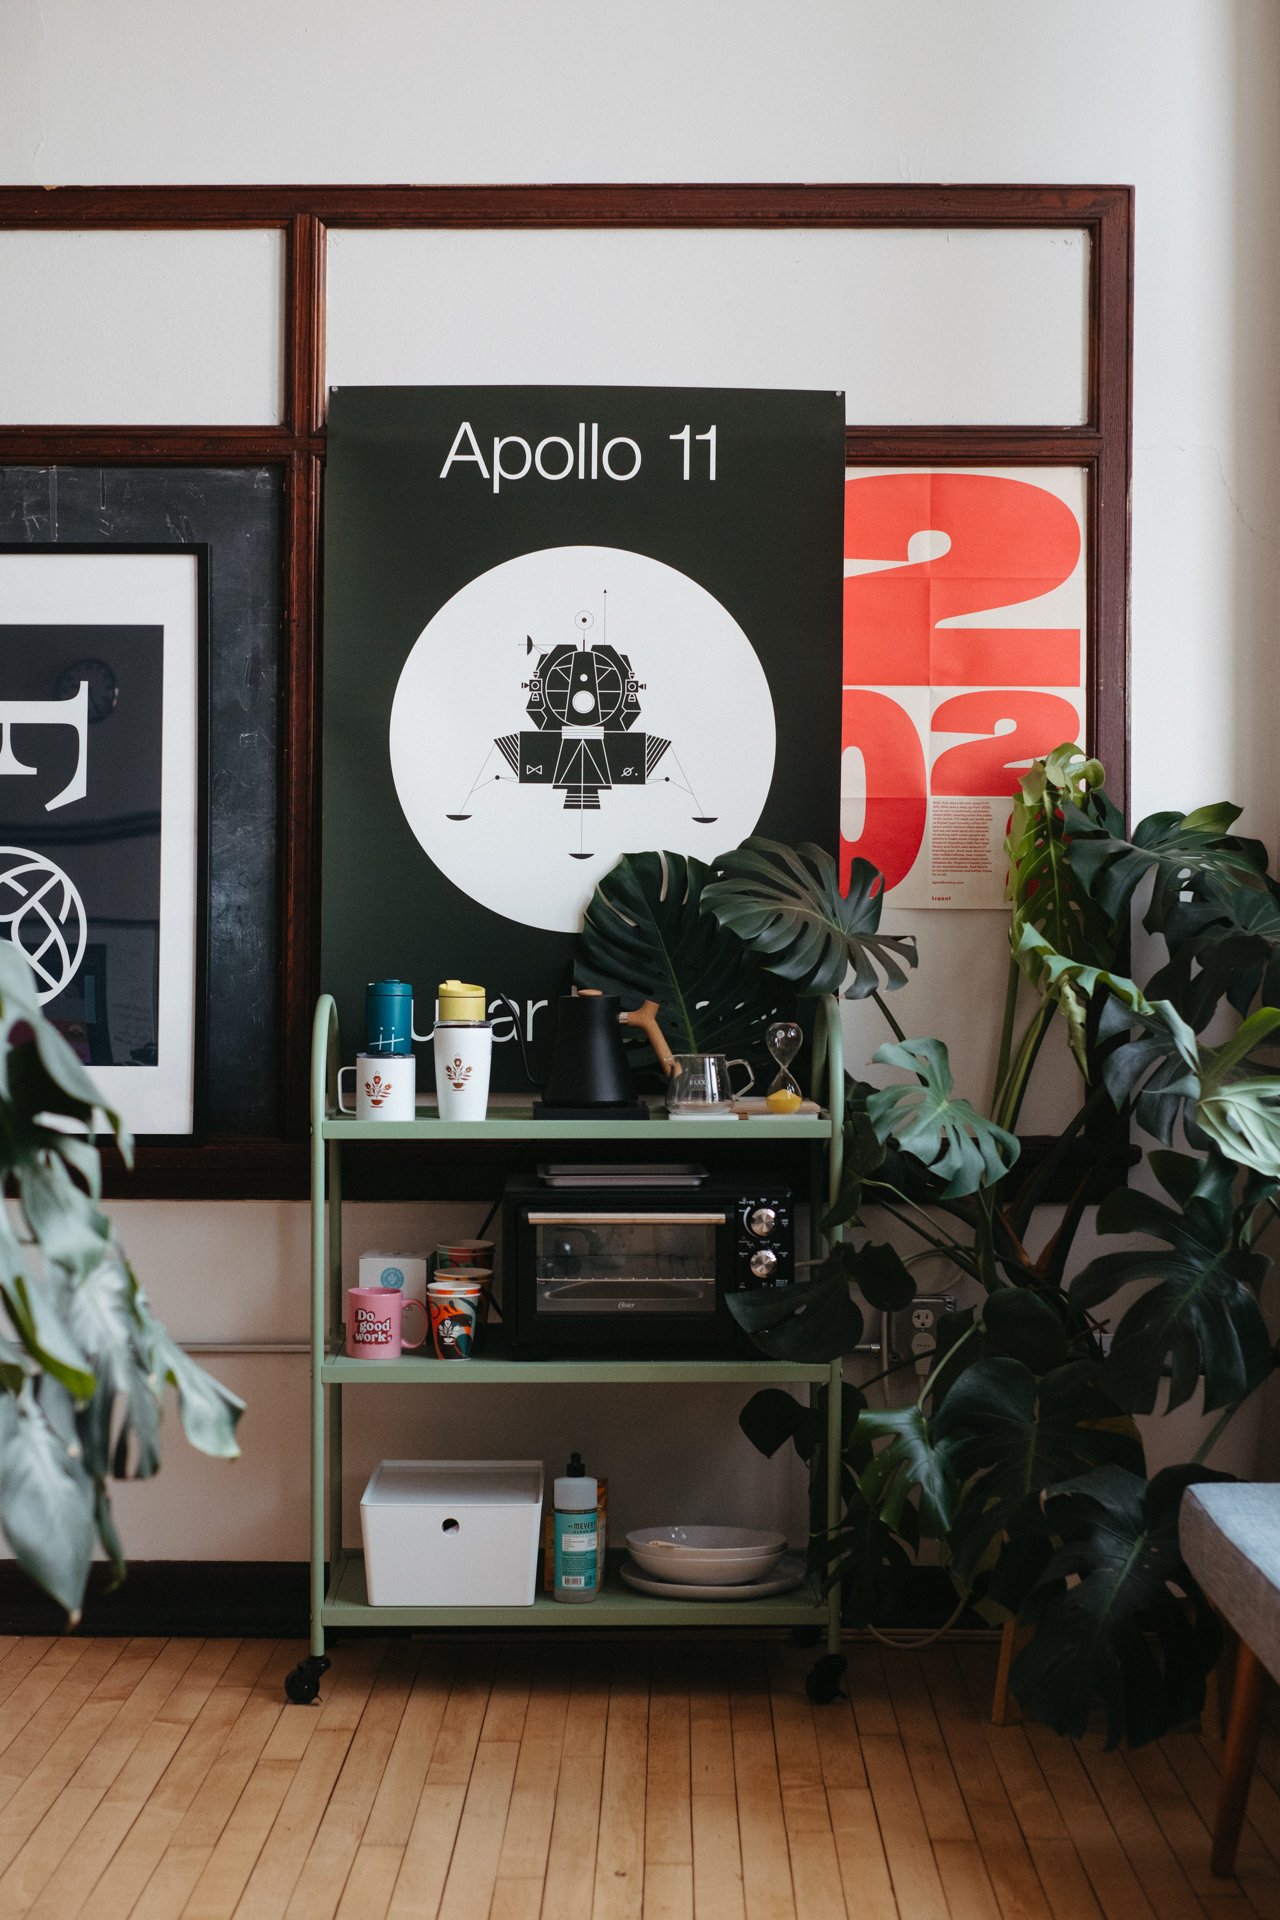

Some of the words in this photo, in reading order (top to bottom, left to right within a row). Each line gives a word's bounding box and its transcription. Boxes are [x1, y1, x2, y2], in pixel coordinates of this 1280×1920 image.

[439, 421, 642, 494] Apollo
[669, 424, 717, 481] 11
[357, 1308, 375, 1321] Do
[359, 1319, 391, 1333] good
[354, 1331, 393, 1342] work.
